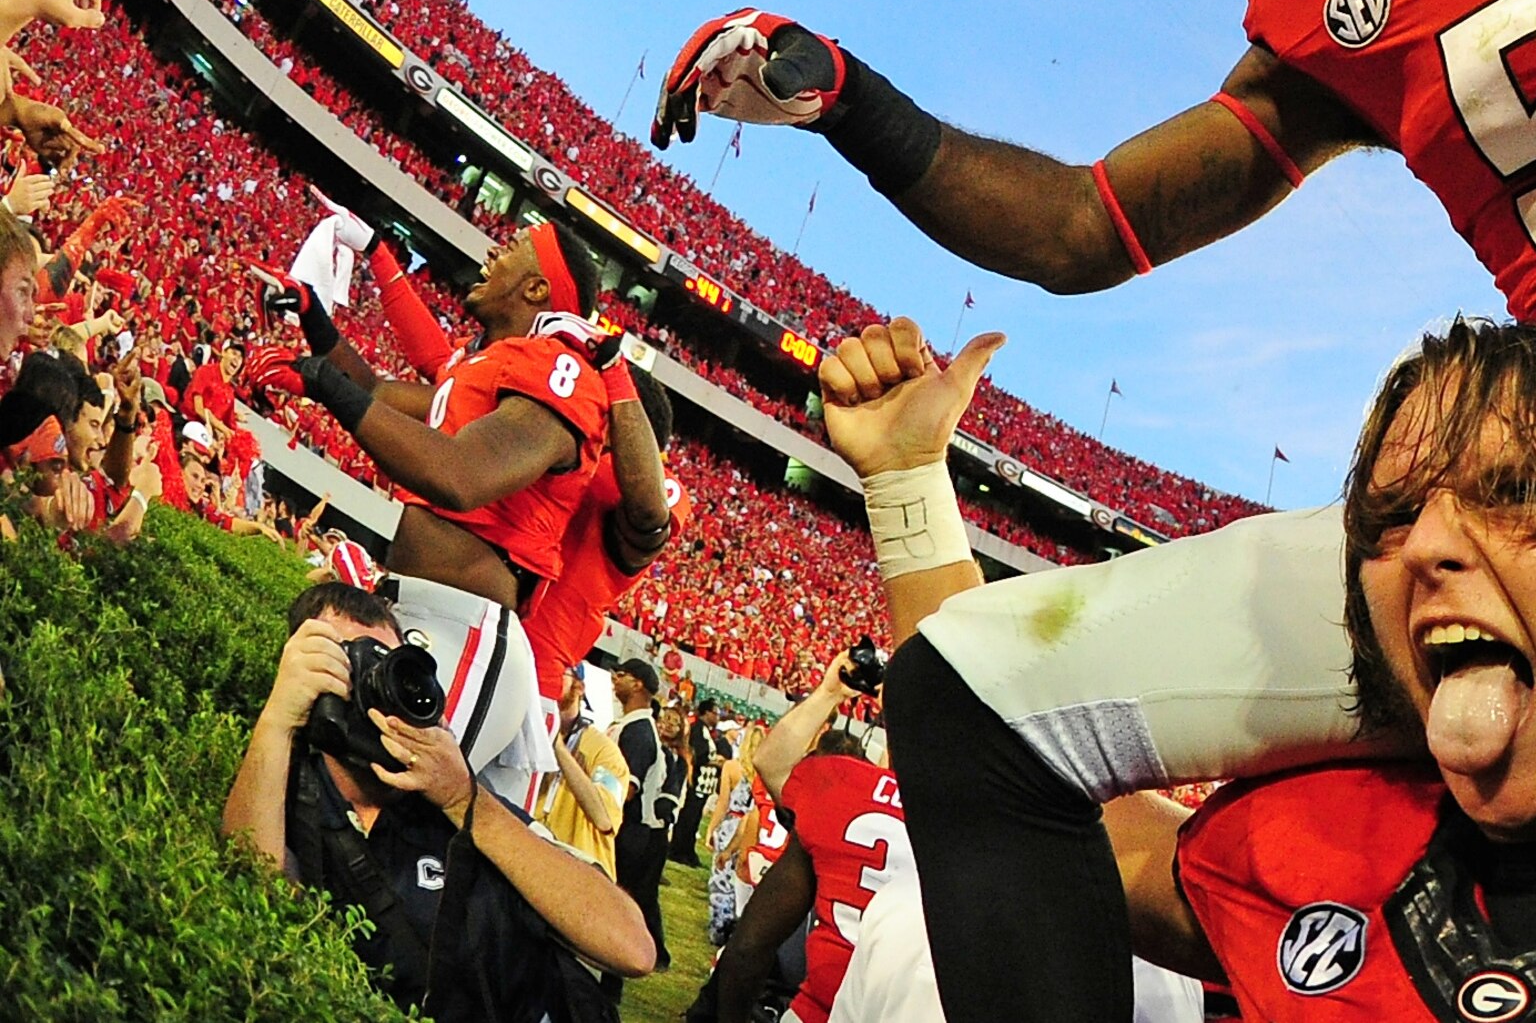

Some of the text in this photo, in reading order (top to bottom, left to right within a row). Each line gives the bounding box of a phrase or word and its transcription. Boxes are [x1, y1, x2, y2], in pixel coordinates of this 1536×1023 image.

[411, 67, 434, 90] G
[539, 169, 562, 190] G
[548, 353, 582, 399] 8
[416, 855, 445, 890] C
[1282, 908, 1362, 988] SEC
[1469, 979, 1526, 1015] G
